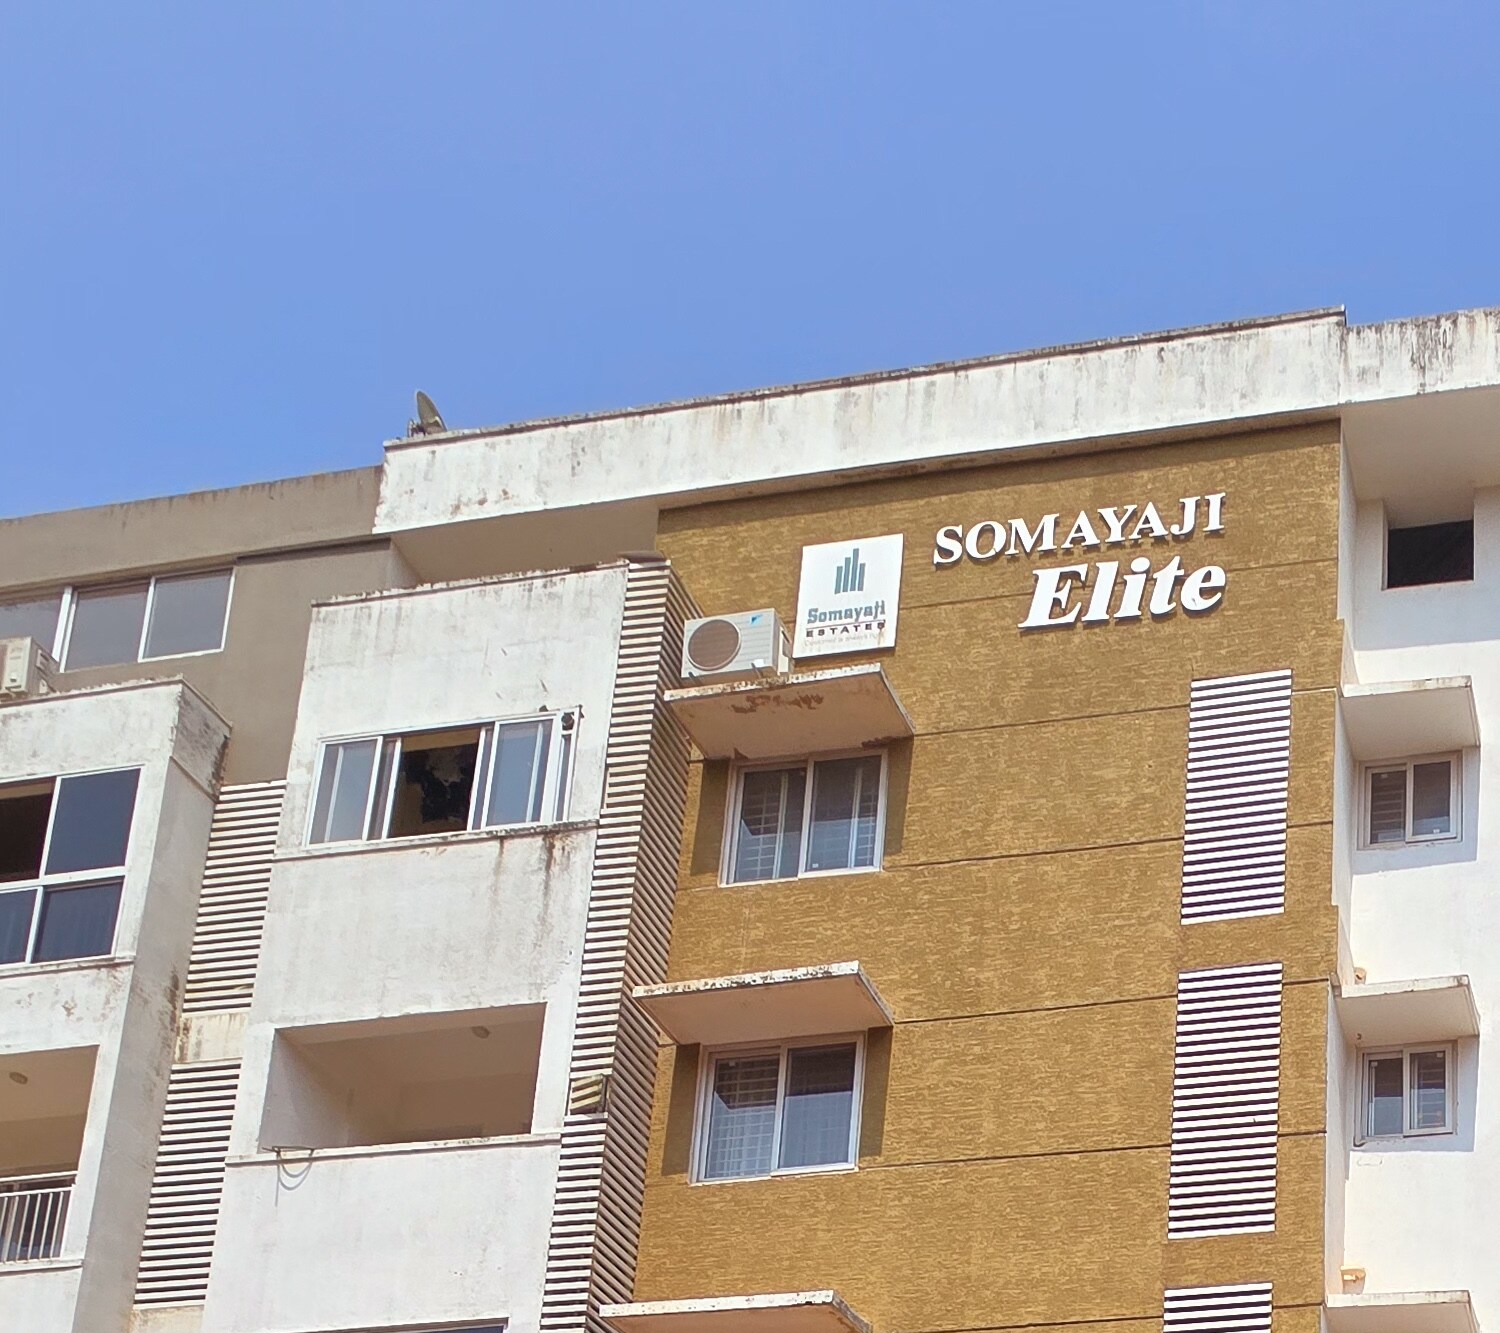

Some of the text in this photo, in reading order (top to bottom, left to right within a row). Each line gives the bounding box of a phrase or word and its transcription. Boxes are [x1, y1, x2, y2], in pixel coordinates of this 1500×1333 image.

[934, 493, 1226, 565] SOMAYAJI
[807, 600, 886, 624] Somayaji
[1018, 555, 1226, 629] Elite
[806, 621, 886, 638] ESTATES
